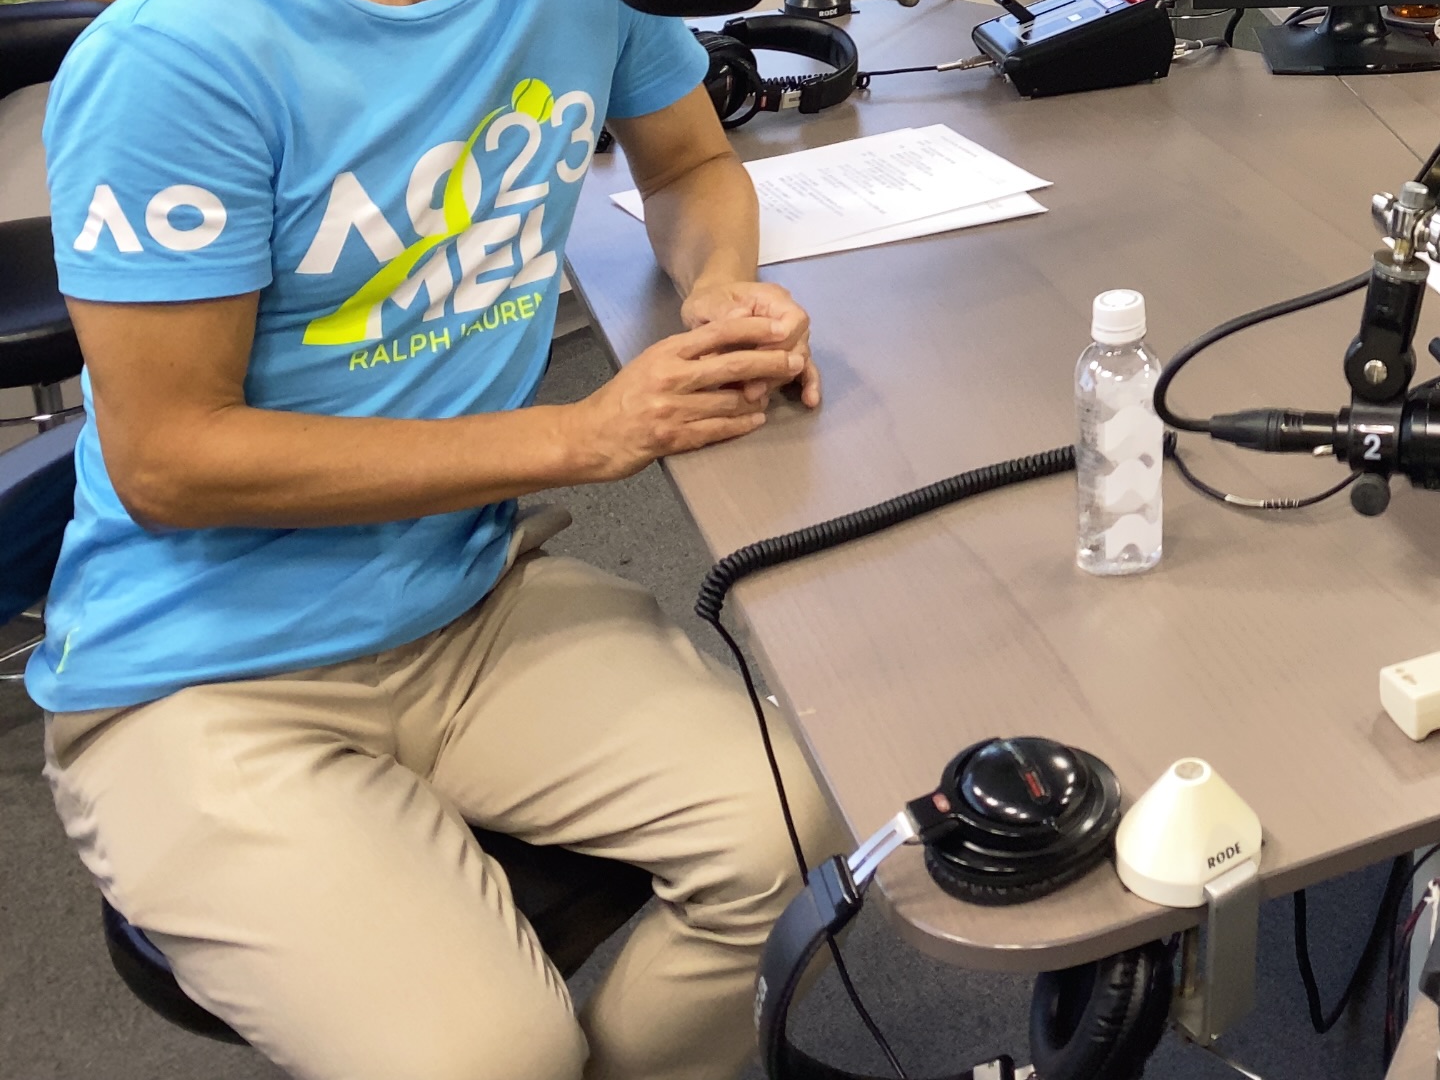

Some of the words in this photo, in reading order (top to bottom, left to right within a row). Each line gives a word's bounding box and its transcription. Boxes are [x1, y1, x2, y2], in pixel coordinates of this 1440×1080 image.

[74, 184, 226, 252] AO
[364, 204, 557, 339] MEL
[349, 328, 450, 371] RALPH
[1363, 434, 1382, 461] 2
